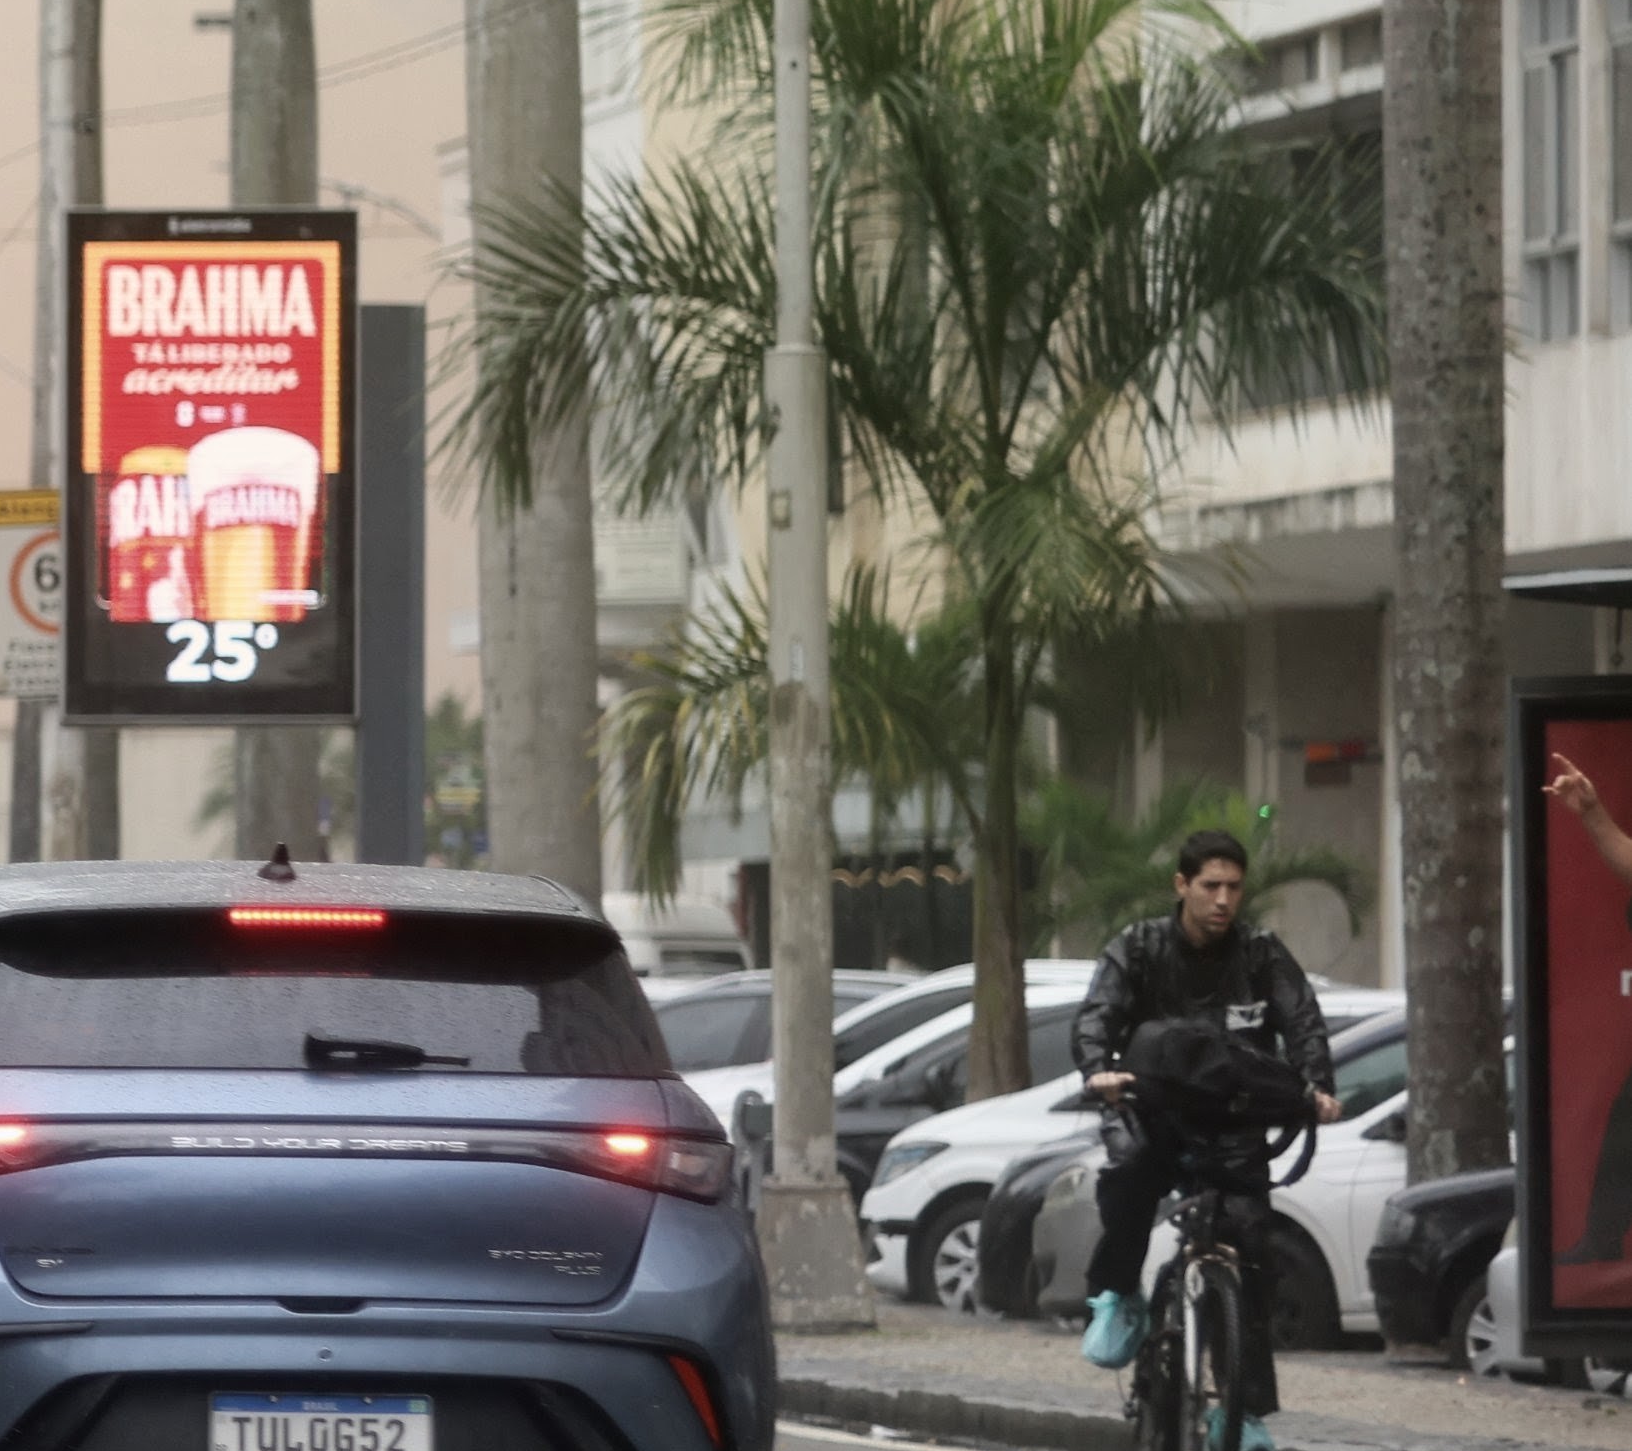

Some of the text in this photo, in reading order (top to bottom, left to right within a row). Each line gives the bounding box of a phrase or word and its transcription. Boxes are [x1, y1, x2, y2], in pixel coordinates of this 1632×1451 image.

[109, 264, 316, 337] BRAHMA
[35, 555, 60, 593] 6
[170, 1136, 469, 1153] BUILD YOUR DREAMS
